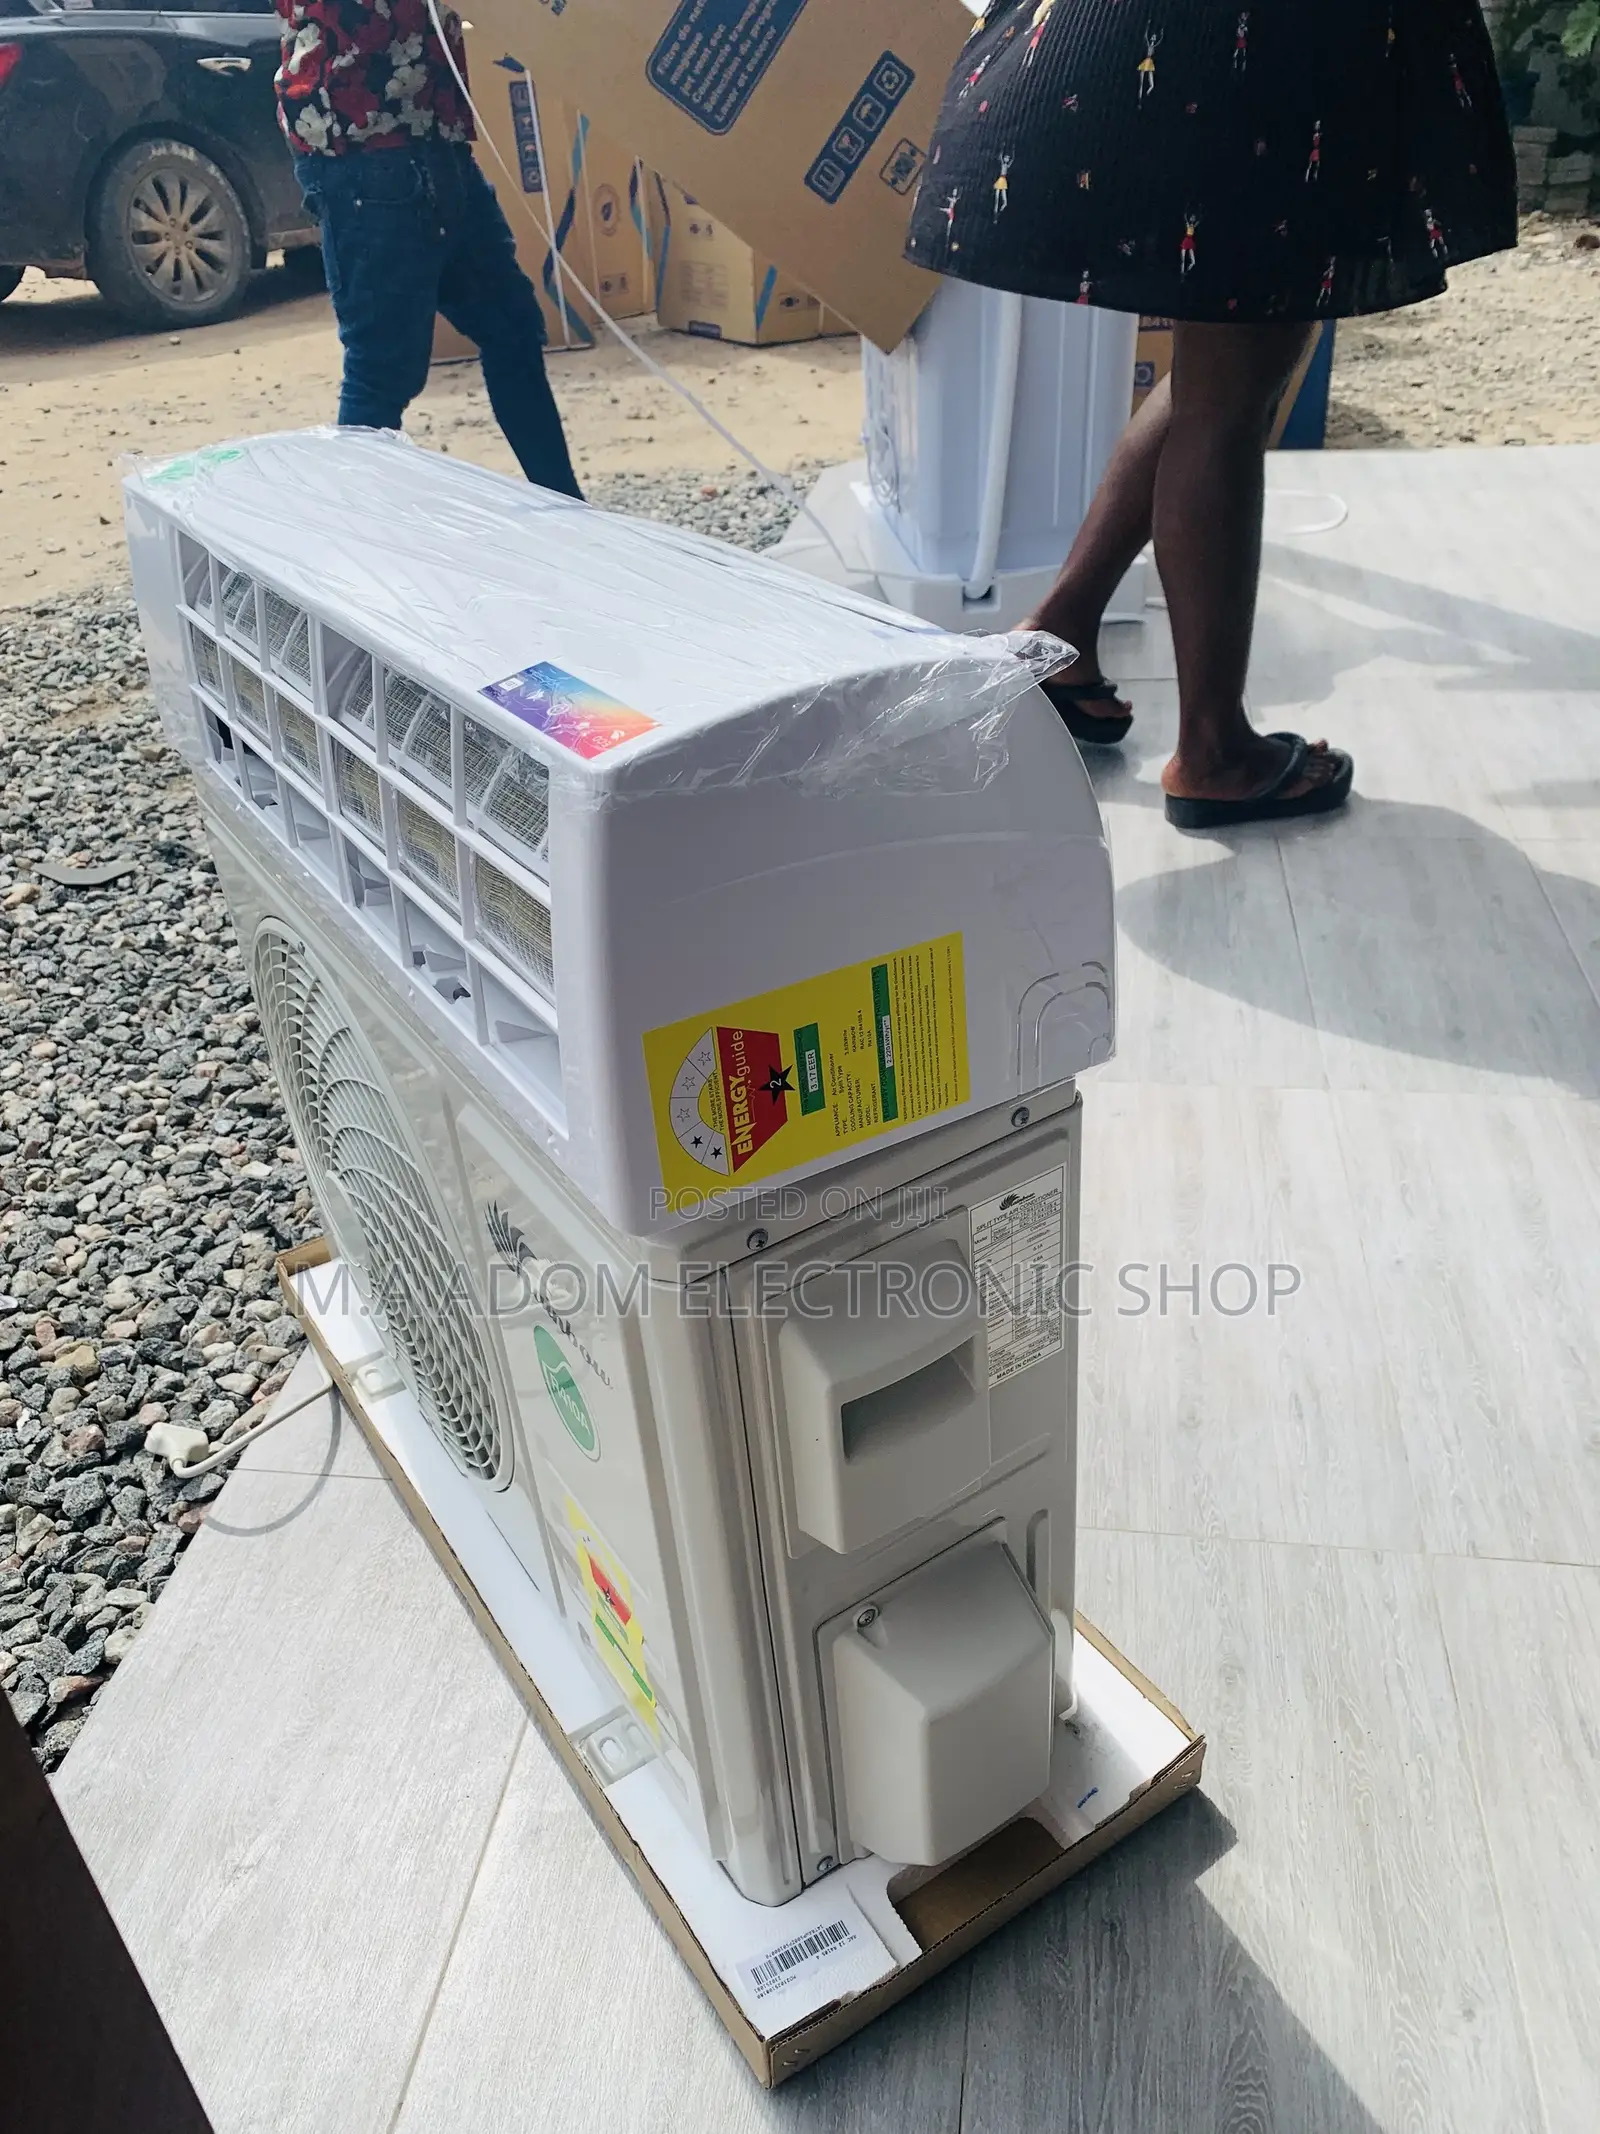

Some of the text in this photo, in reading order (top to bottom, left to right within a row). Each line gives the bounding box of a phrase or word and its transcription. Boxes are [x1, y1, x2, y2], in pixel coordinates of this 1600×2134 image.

[769, 1077, 782, 1089] 2
[808, 1052, 818, 1089] 3.17 EER
[1009, 1207, 1018, 1216] AIR
[1019, 1187, 1057, 1211] CONDITIONER
[996, 1351, 1041, 1379] MADE IN CHINA
